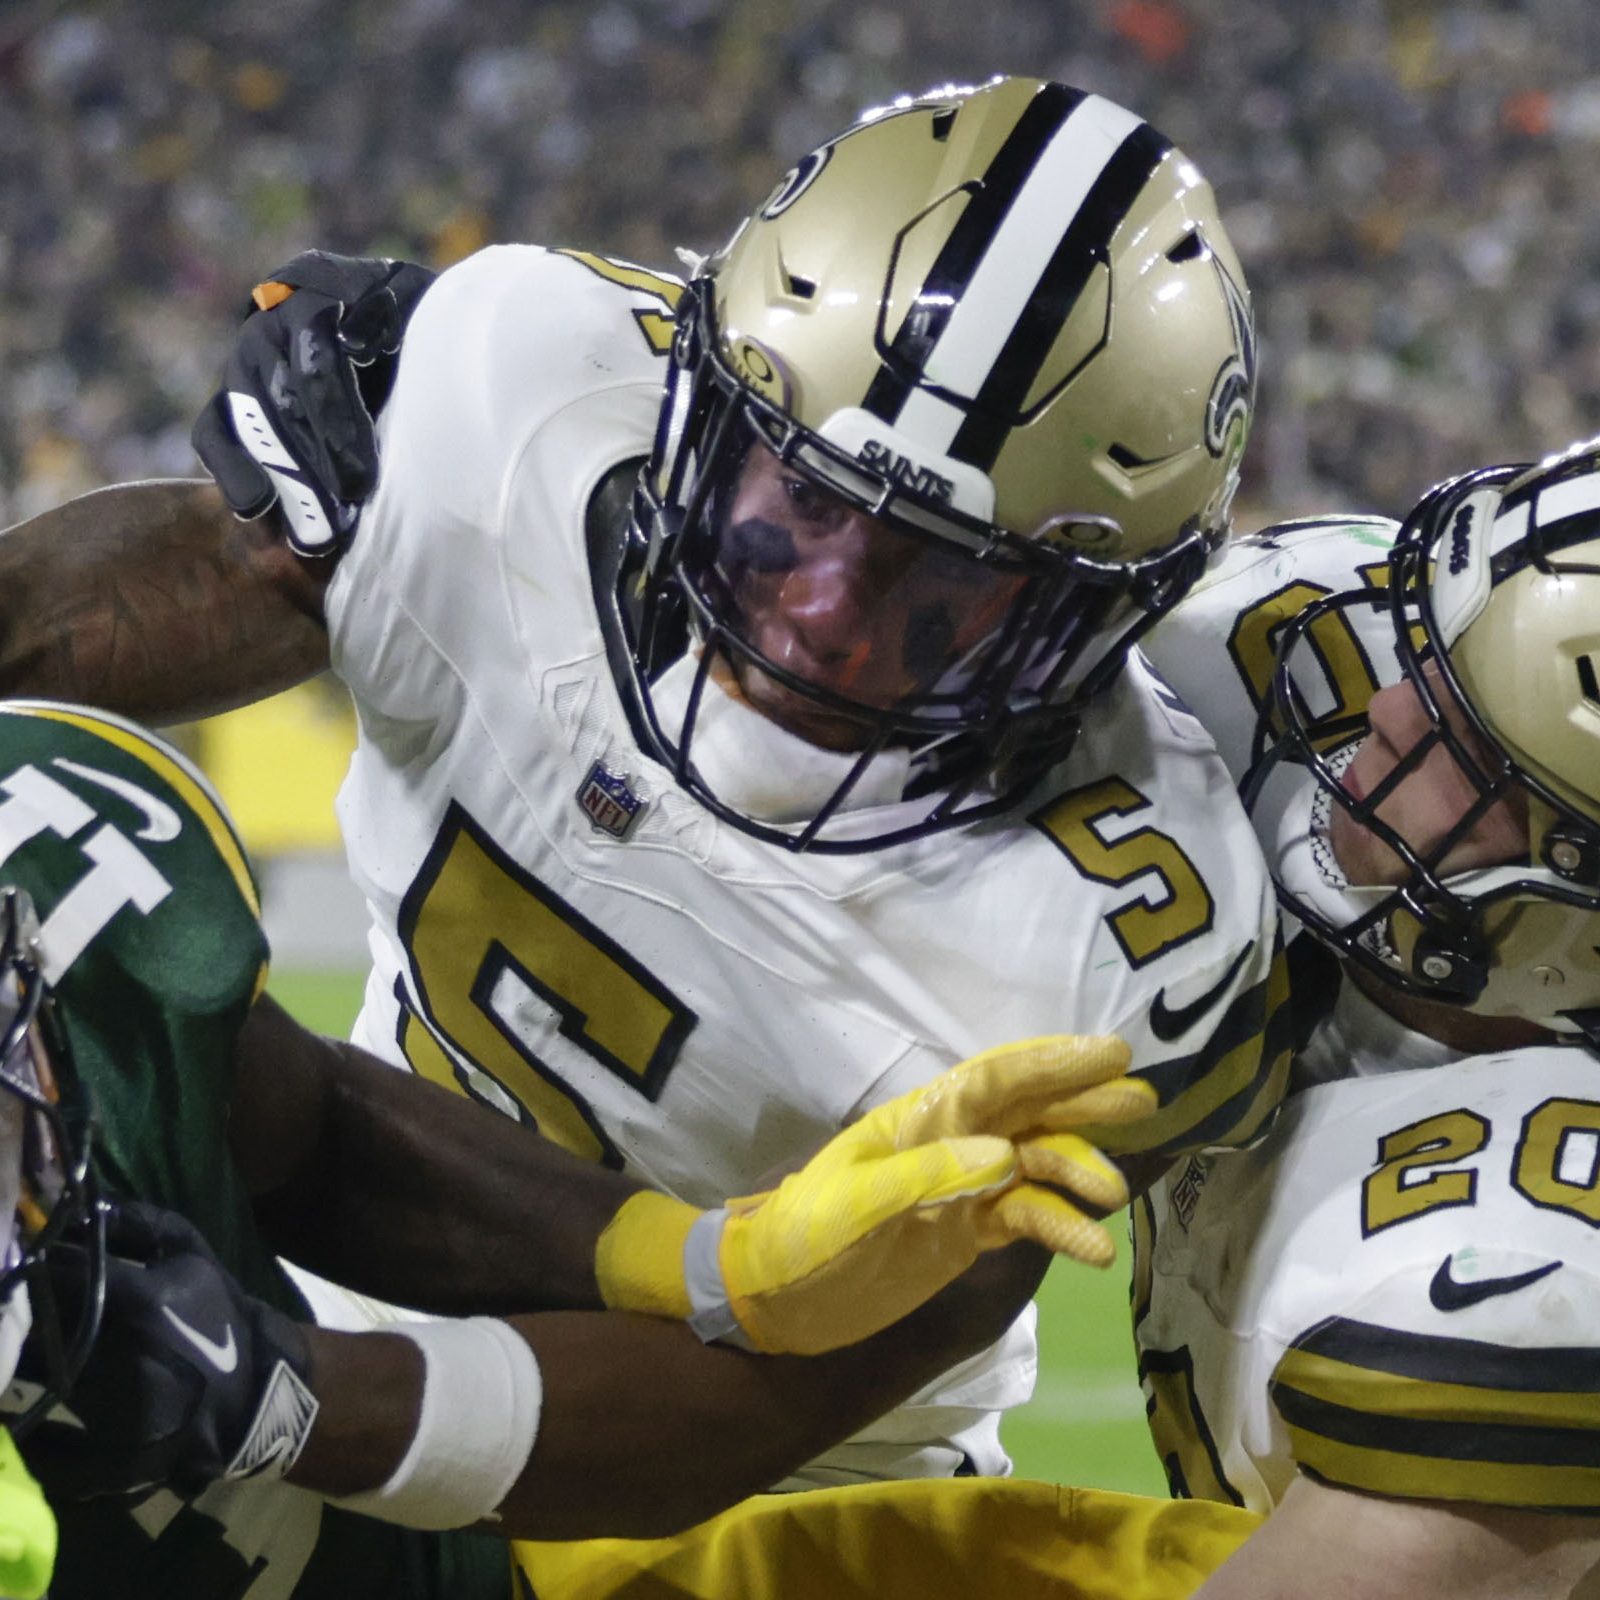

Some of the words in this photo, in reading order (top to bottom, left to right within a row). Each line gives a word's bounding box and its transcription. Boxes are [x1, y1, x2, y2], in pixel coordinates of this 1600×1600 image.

[582, 781, 631, 831] NFL
[1028, 774, 1215, 972] 5
[398, 798, 699, 1170] 5
